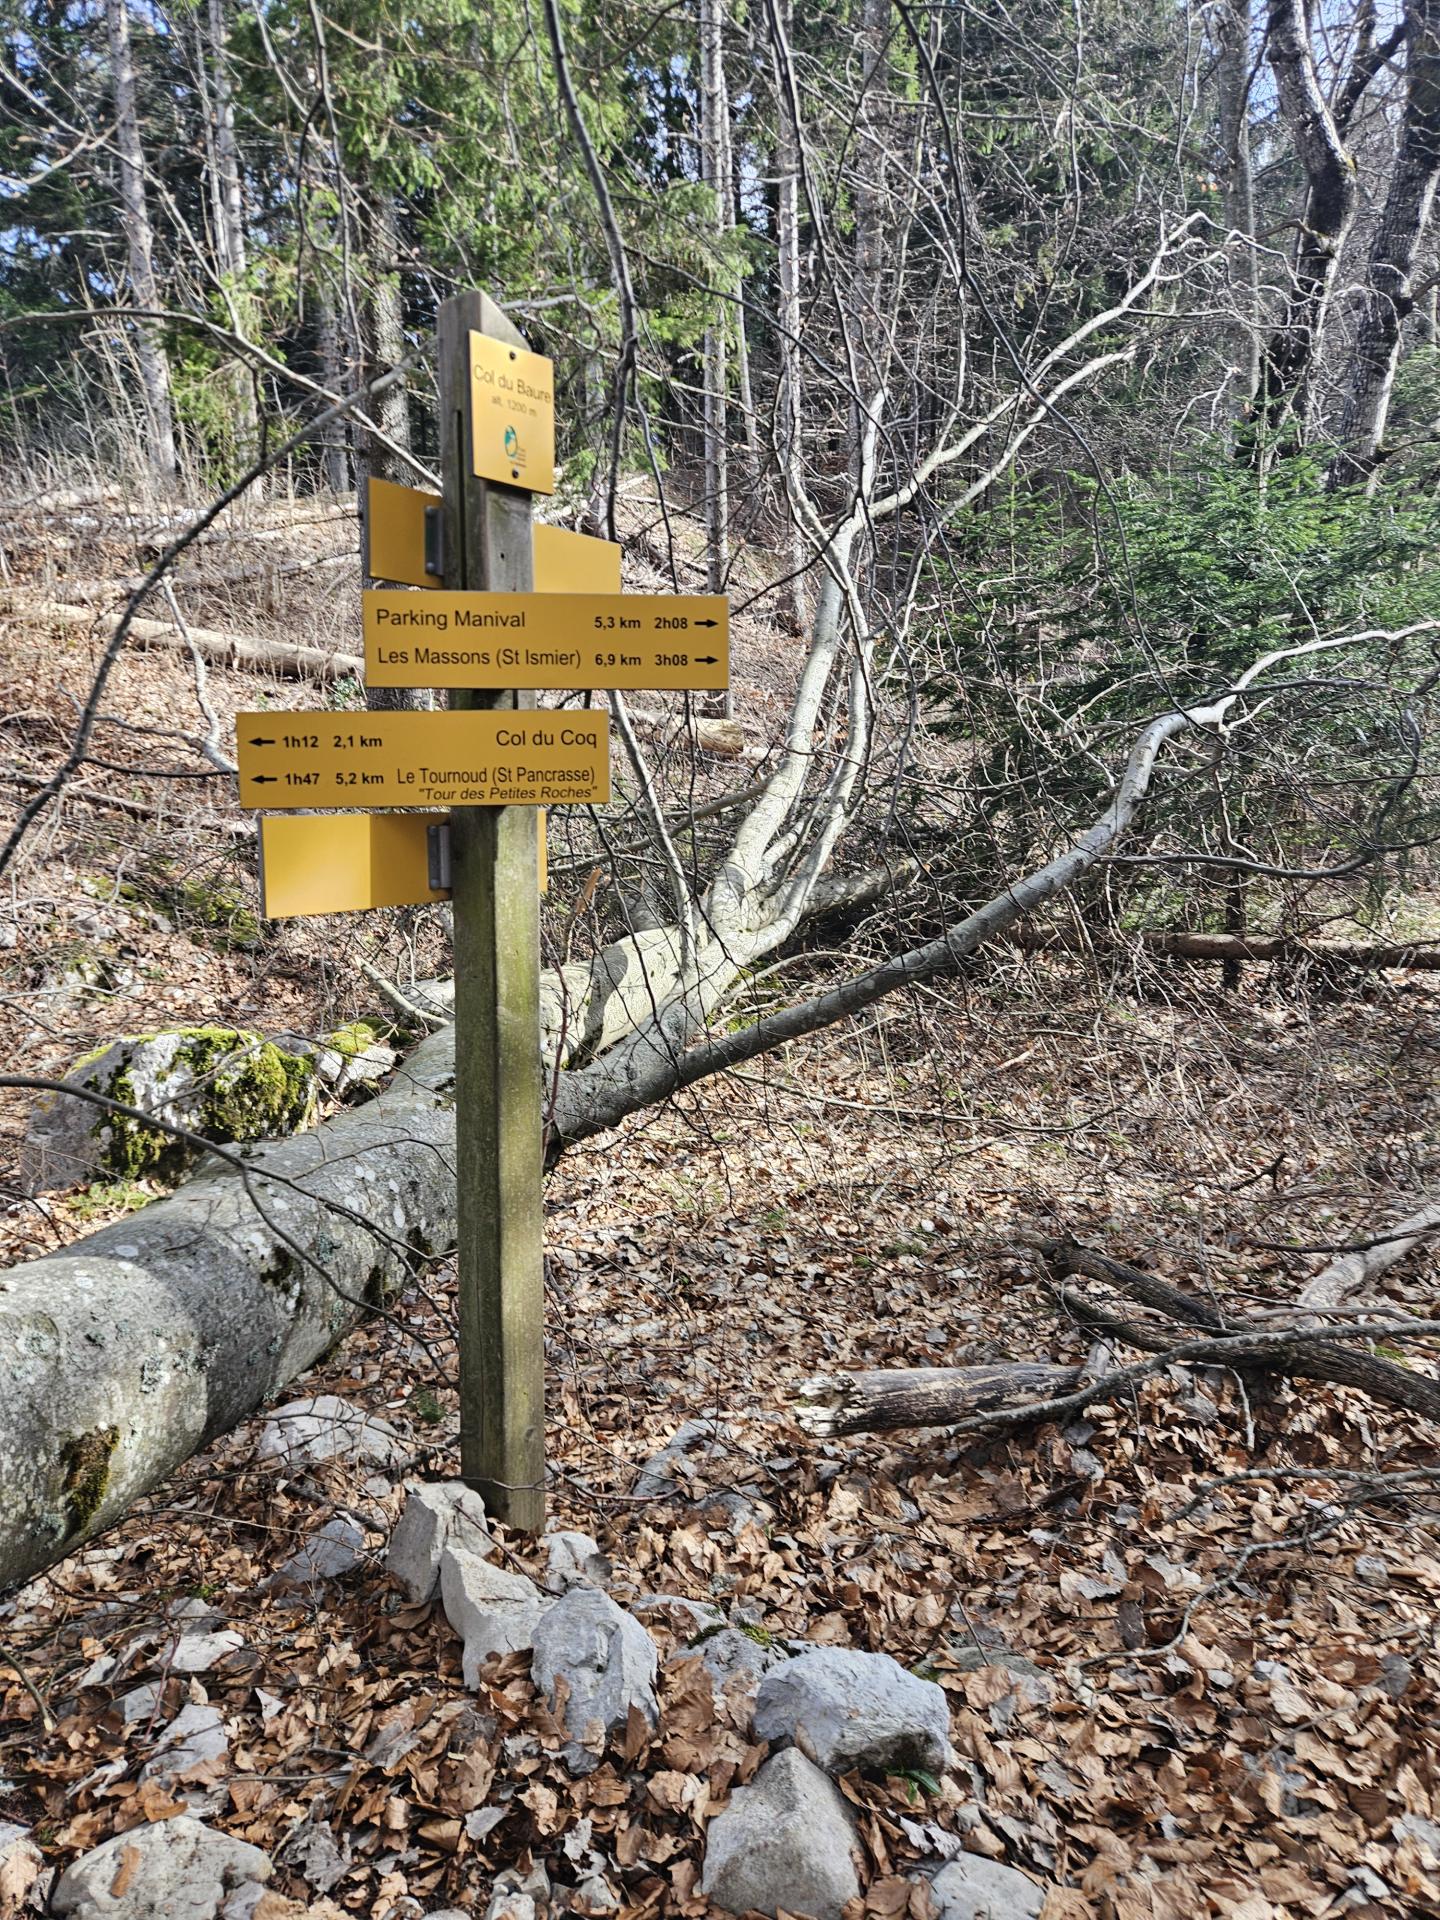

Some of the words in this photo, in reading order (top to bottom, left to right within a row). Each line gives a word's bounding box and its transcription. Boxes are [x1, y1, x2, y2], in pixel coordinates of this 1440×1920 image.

[474, 364, 495, 386] Col
[498, 374, 514, 391] du
[517, 378, 551, 404] Baure
[376, 608, 448, 630] Parking
[454, 610, 526, 628] Manival
[594, 616, 615, 630] 5,3
[620, 617, 641, 628] km
[654, 617, 688, 629] 2h08
[378, 648, 408, 664] Les
[414, 648, 490, 664] Massons
[496, 648, 520, 668] (St
[526, 649, 582, 668] Ismier)
[595, 654, 616, 667] 6,9
[620, 654, 642, 666] km
[655, 654, 688, 666] 3h08
[282, 736, 319, 748] 1h12
[334, 736, 354, 749] 2,1
[360, 735, 382, 748] km
[496, 730, 526, 746] Col
[532, 730, 554, 746] du
[560, 729, 597, 748] Coq
[285, 773, 320, 785] 1h47
[336, 773, 356, 786] 5,2
[362, 772, 384, 784] km
[397, 768, 415, 784] Le
[419, 768, 487, 784] Tournoud
[492, 766, 512, 786] (St
[517, 766, 595, 784] Pancrasse)
[418, 788, 456, 800] "Tour
[465, 788, 484, 800] des
[490, 786, 536, 800] Petites
[540, 786, 598, 798] Roches"
